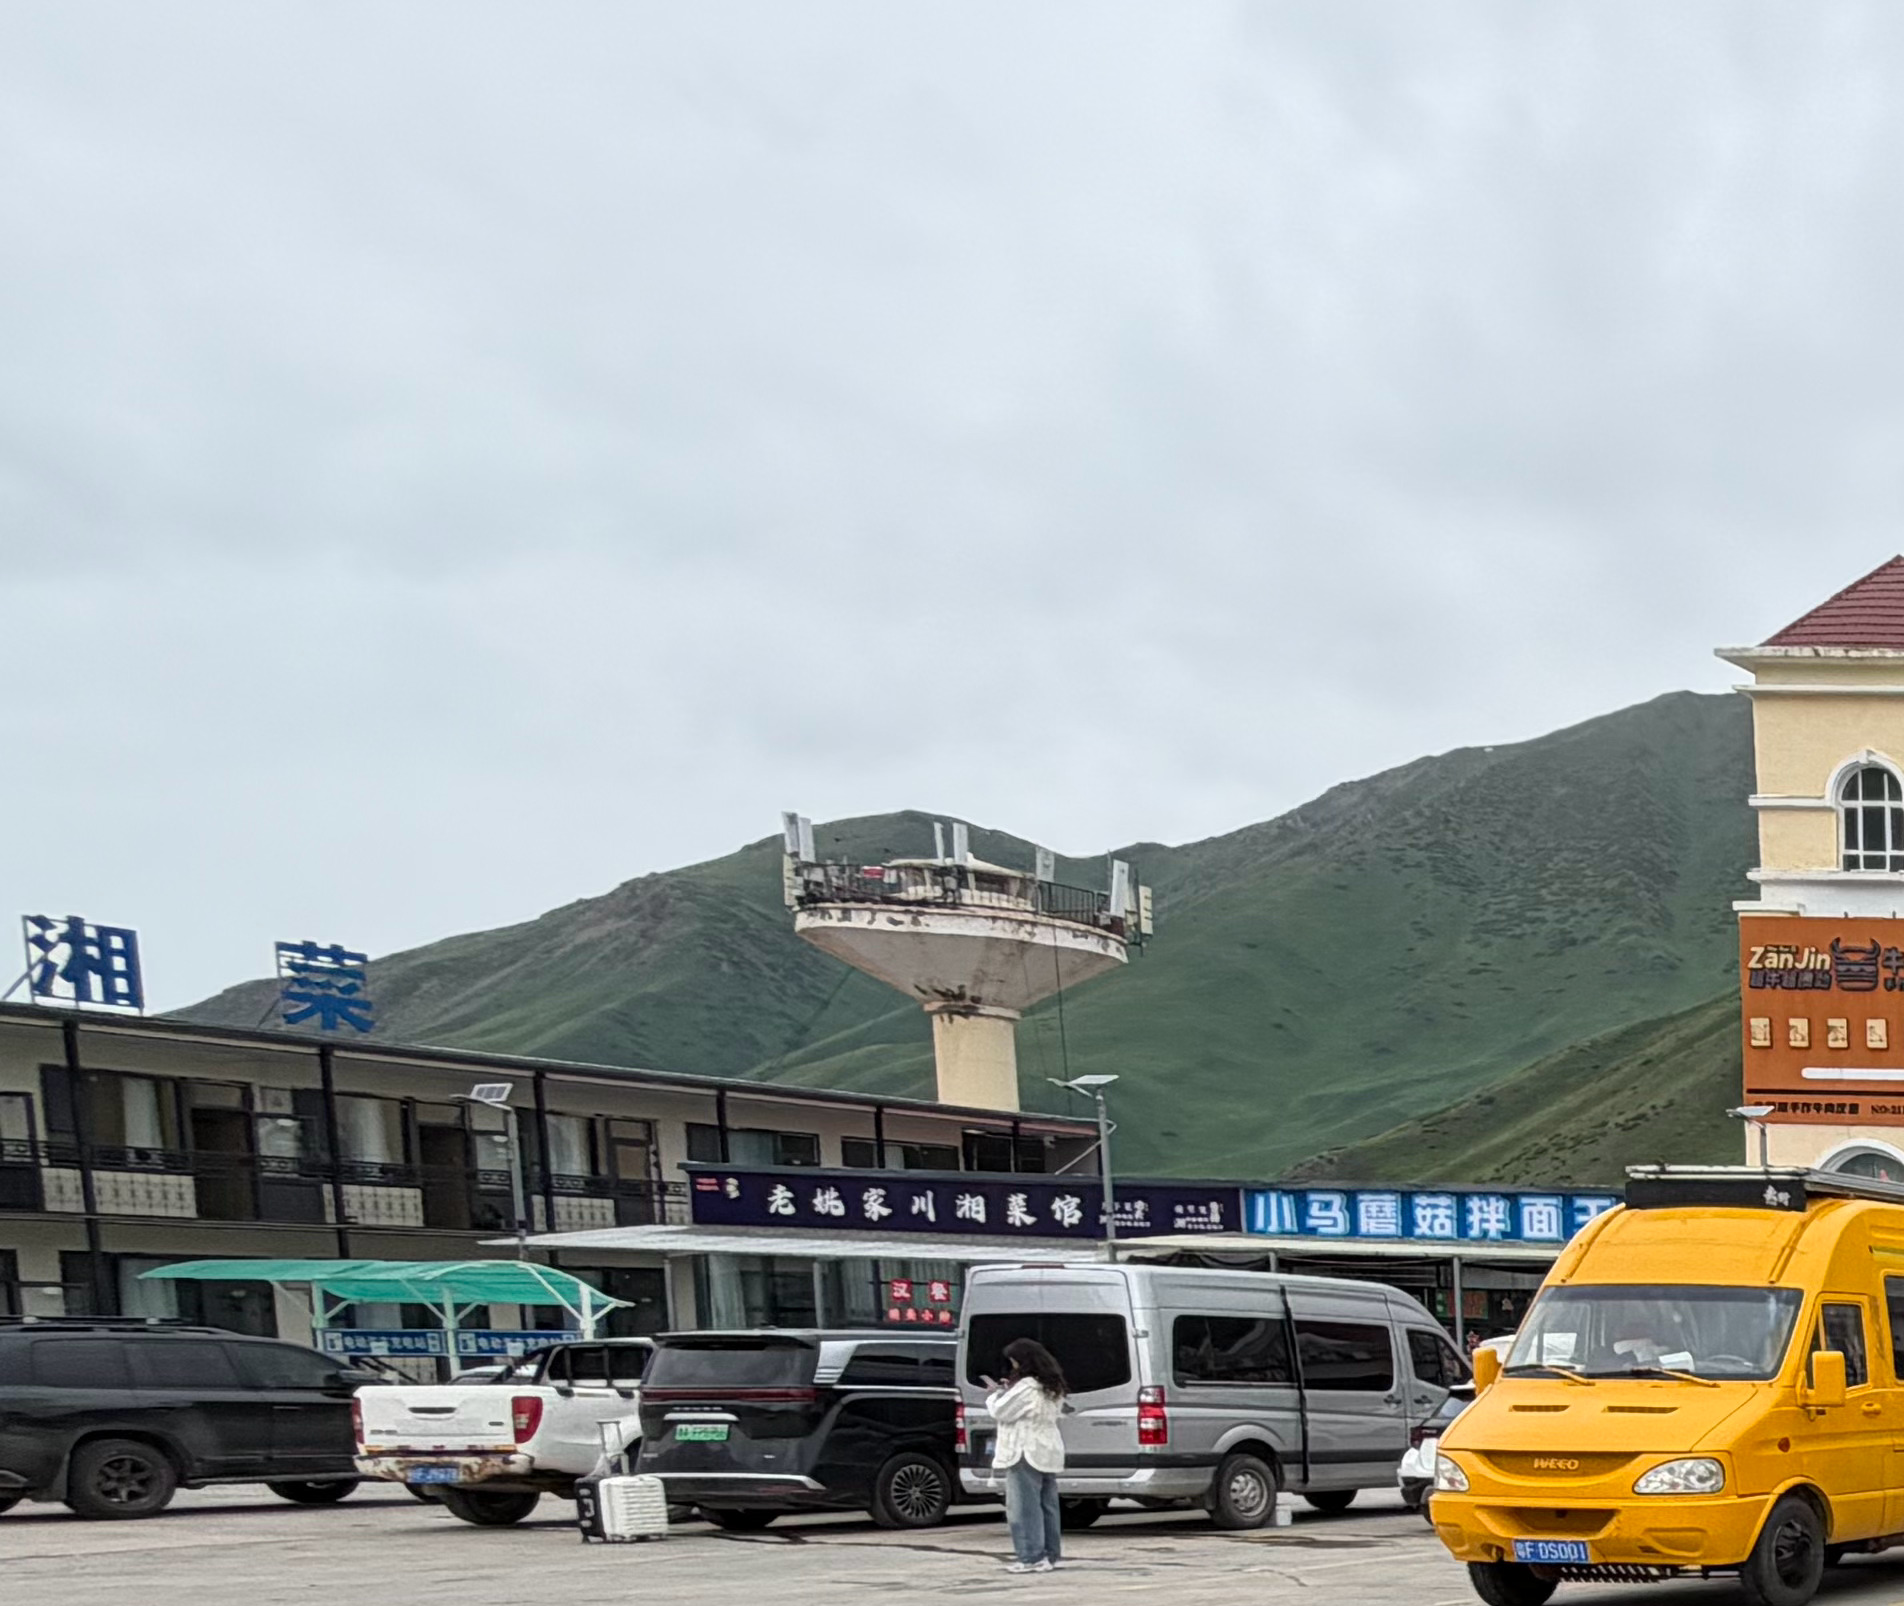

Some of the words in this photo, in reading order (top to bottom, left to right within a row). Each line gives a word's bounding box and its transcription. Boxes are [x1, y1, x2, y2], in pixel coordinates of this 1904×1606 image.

[767, 1184, 1083, 1228] 老姚家川湘菜馆
